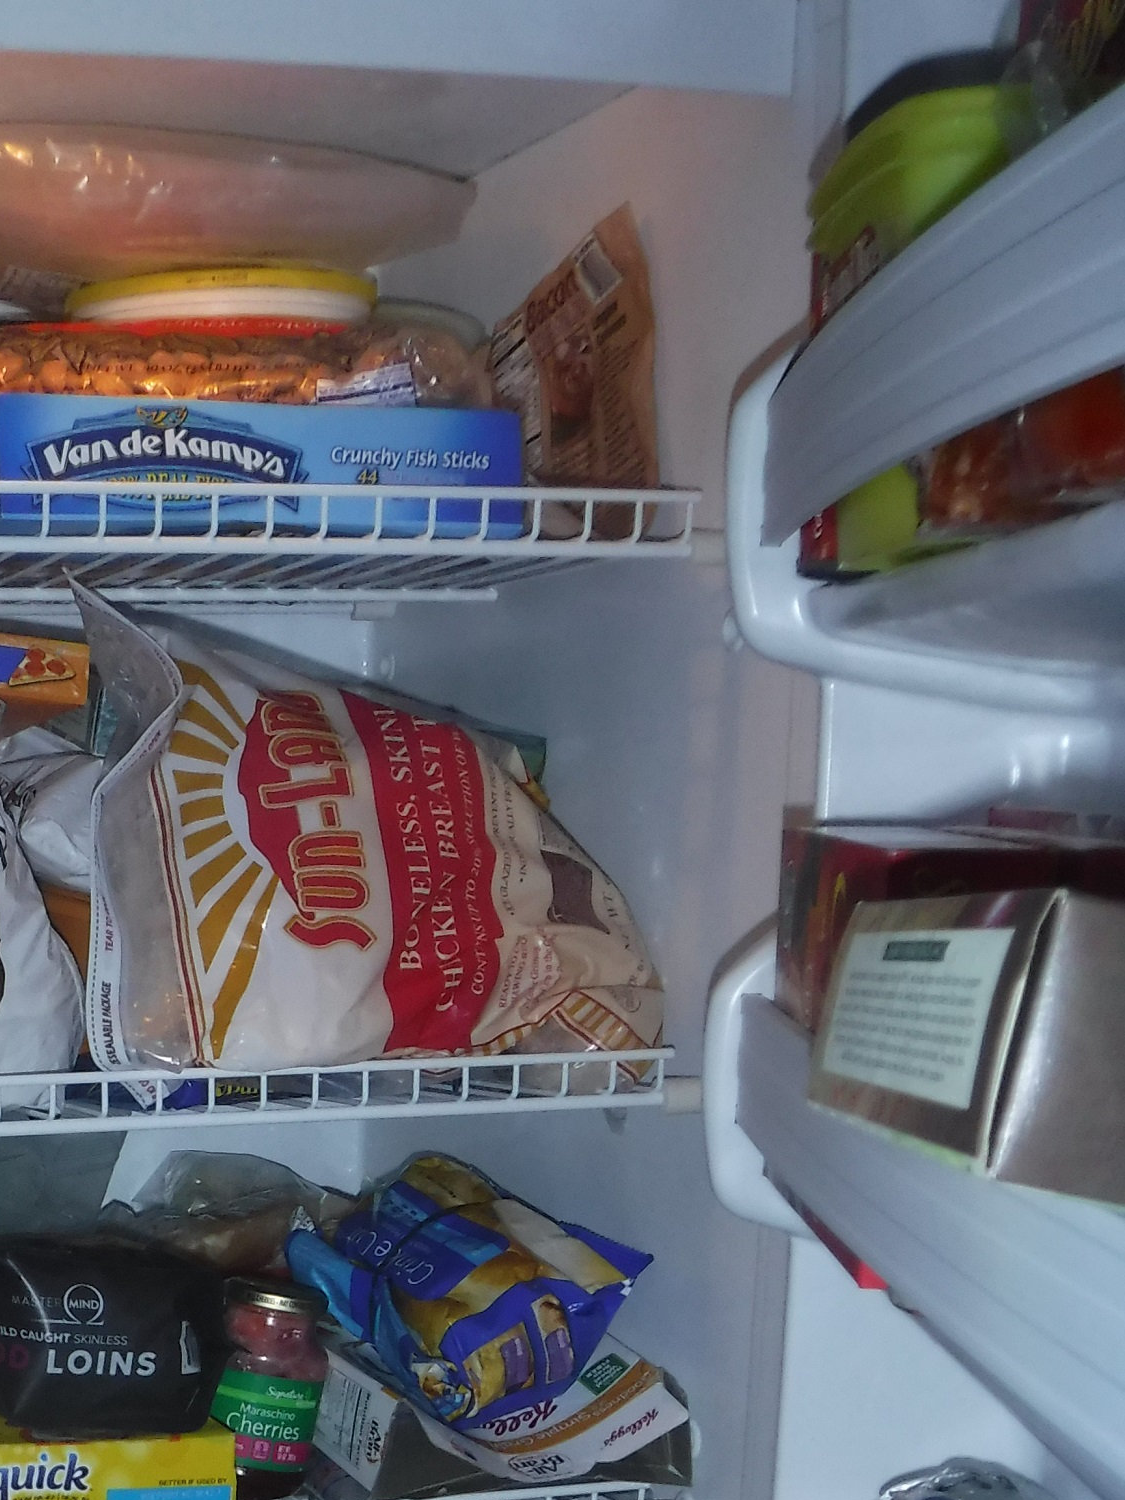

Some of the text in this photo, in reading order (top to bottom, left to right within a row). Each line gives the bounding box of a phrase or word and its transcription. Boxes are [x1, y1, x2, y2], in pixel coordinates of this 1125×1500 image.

[43, 428, 286, 478] Van de Kamp's
[331, 446, 490, 471] Crunchy Fish Sticks
[423, 740, 462, 1012] CHICKEN BREAST
[105, 930, 114, 952] TEAR
[102, 980, 112, 1016] PACKAGE
[69, 1299, 99, 1310] MIND
[20, 1330, 71, 1344] CAUGHT
[73, 1334, 128, 1346] SKINLESS
[47, 1349, 157, 1376] LOINS
[240, 1403, 296, 1421] Maraschino
[226, 1412, 300, 1440] Cherries
[603, 1408, 660, 1448] Kellogg's
